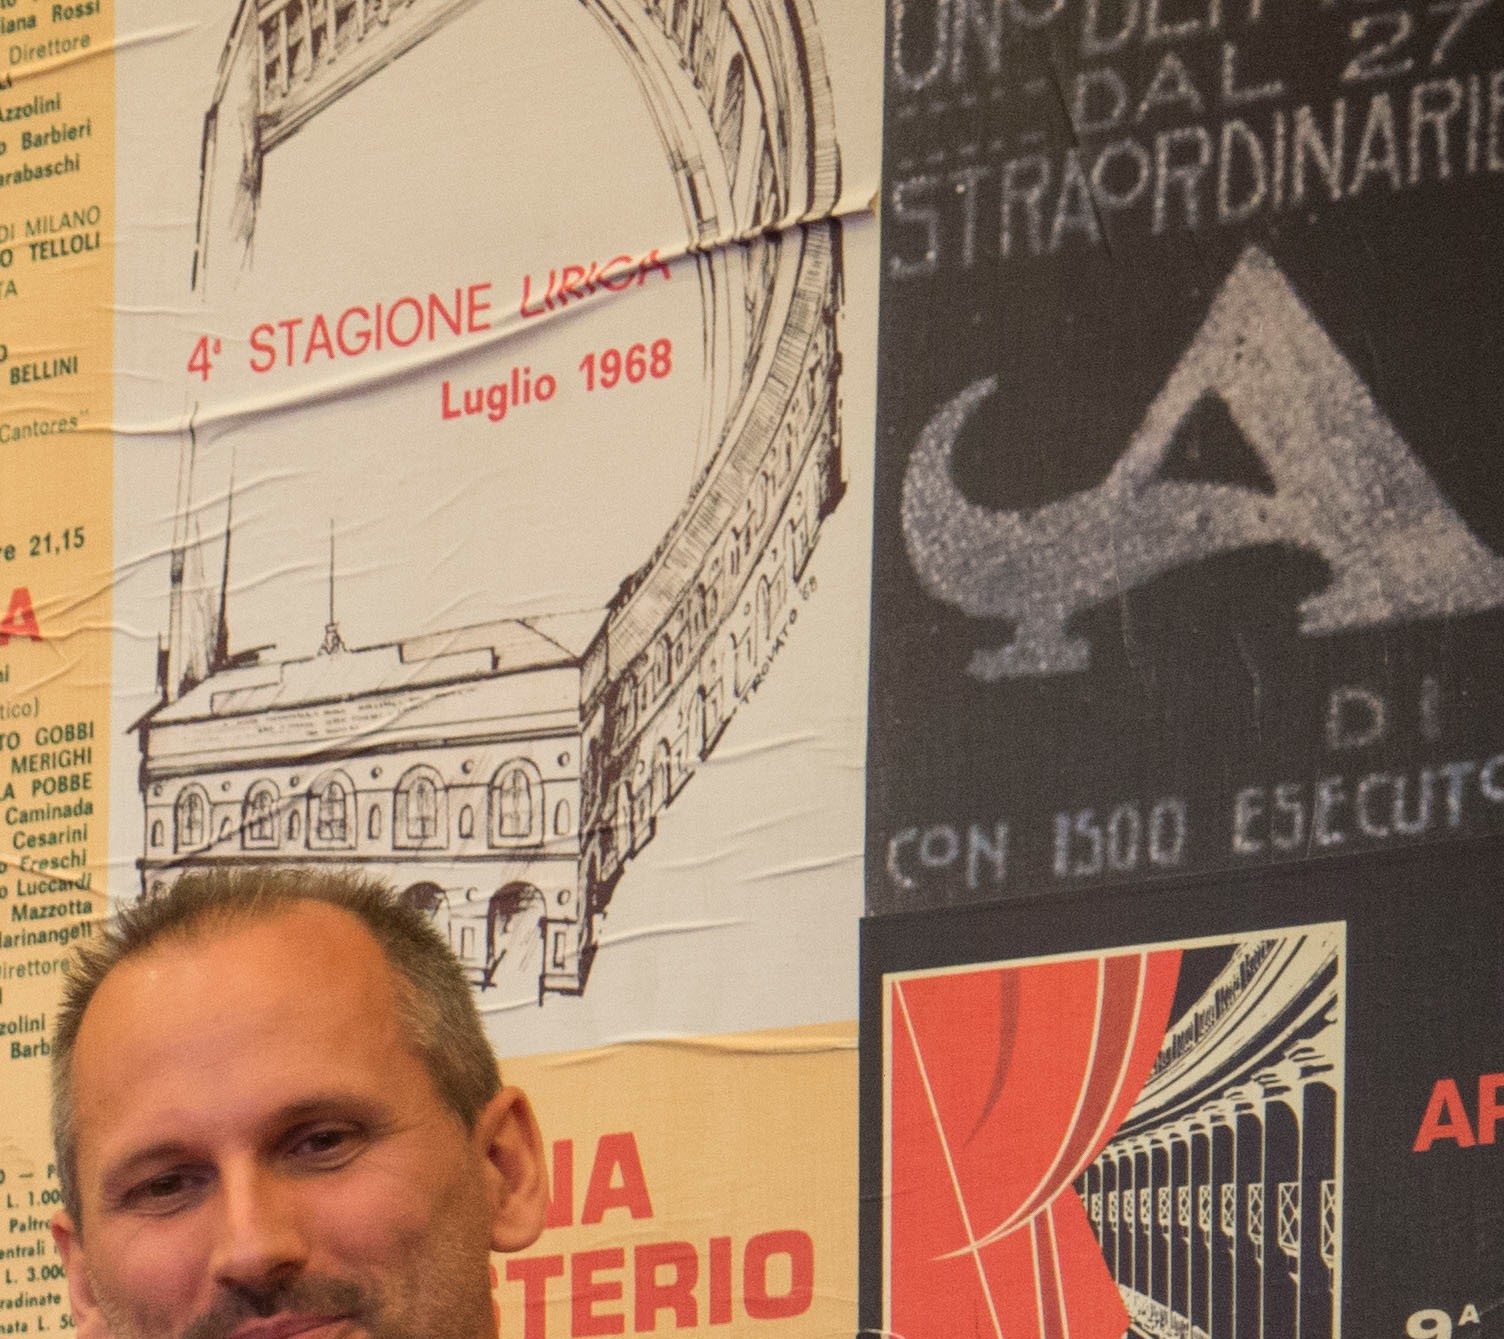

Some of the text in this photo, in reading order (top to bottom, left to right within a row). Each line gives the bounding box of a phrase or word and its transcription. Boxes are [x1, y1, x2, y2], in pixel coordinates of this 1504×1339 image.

[1073, 42, 1284, 135] DAL
[21, 118, 92, 150] Barbieri
[25, 206, 100, 238] MILANO
[29, 232, 100, 262] TELLOLI
[248, 284, 491, 377] STAGIONE
[10, 356, 79, 385] BELLINI
[441, 339, 674, 422] Luglio 1968
[29, 527, 85, 557] 21,15
[35, 721, 95, 747] GOBBI
[11, 748, 93, 775] MERIGHI
[32, 773, 92, 798] POBBE
